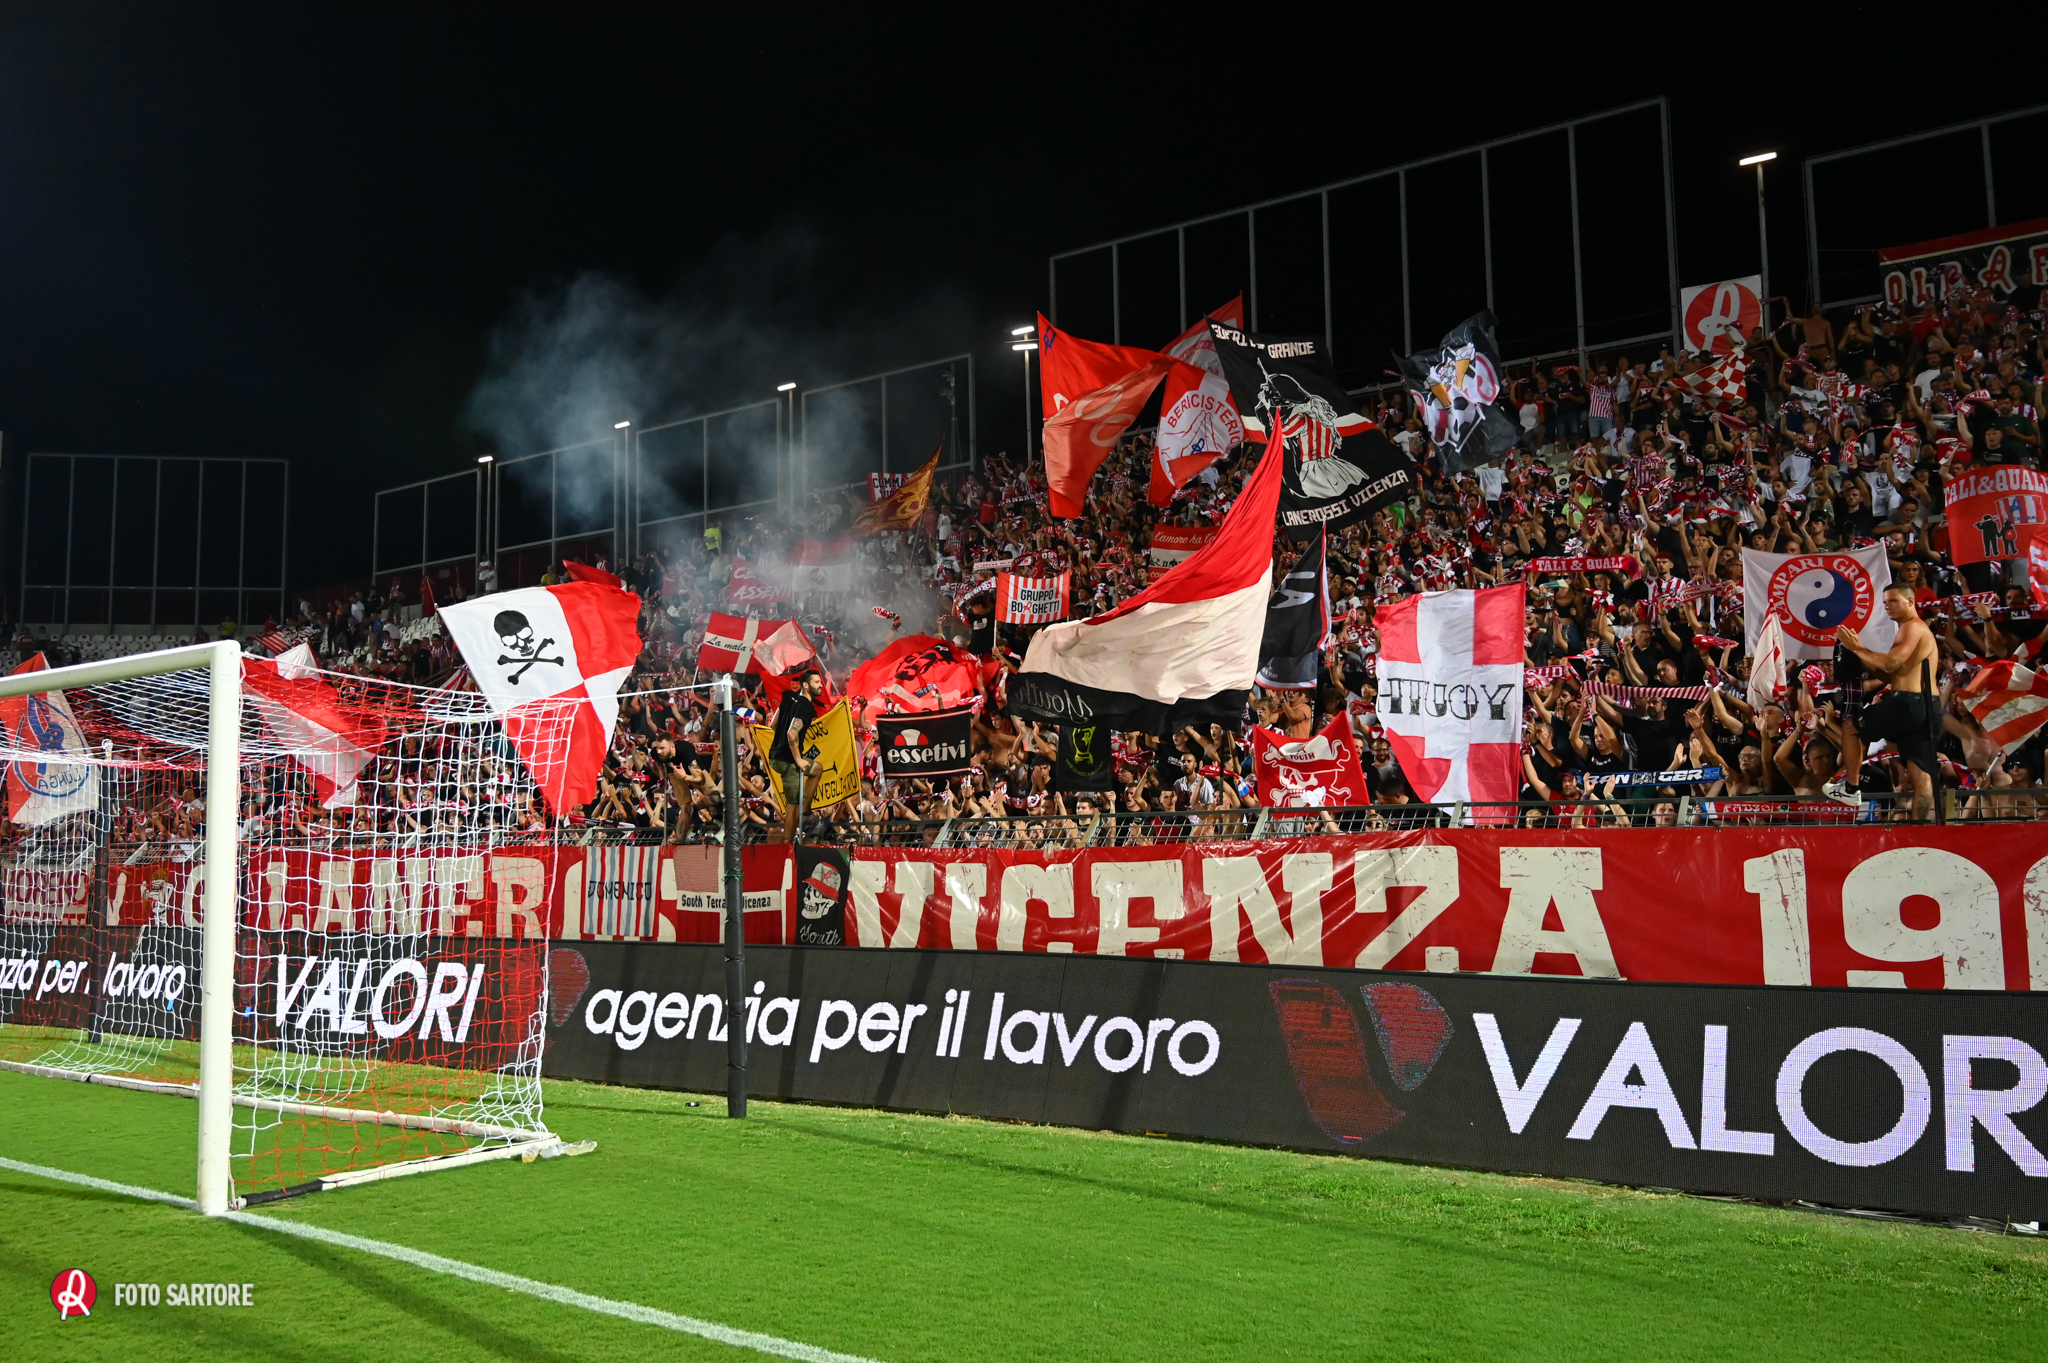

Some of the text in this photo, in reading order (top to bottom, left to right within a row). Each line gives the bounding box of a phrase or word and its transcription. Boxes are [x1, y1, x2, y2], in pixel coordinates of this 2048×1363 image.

[1267, 342, 1316, 359] GRANDE
[1282, 469, 1409, 527] LANEROSSI VICENZA
[1536, 556, 1624, 572] TALI & QUALI
[1021, 589, 1054, 602] GRUPPO
[1832, 558, 1870, 620] GROUP
[706, 636, 721, 647] La
[724, 643, 747, 652] mala
[1801, 629, 1839, 641] VICEN
[887, 739, 966, 764] essetivi
[1290, 752, 1315, 761] YOUTH
[588, 880, 652, 901] DOMENICO
[681, 893, 703, 908] South
[848, 844, 1625, 980] VICENZA
[1743, 845, 2048, 992] 19
[800, 922, 841, 946] Youth
[35, 959, 89, 1002] per
[103, 951, 187, 1001] lavoro
[276, 953, 486, 1043] VALORI
[810, 999, 927, 1063] per
[936, 989, 971, 1058] il
[984, 992, 1221, 1077] lavoro
